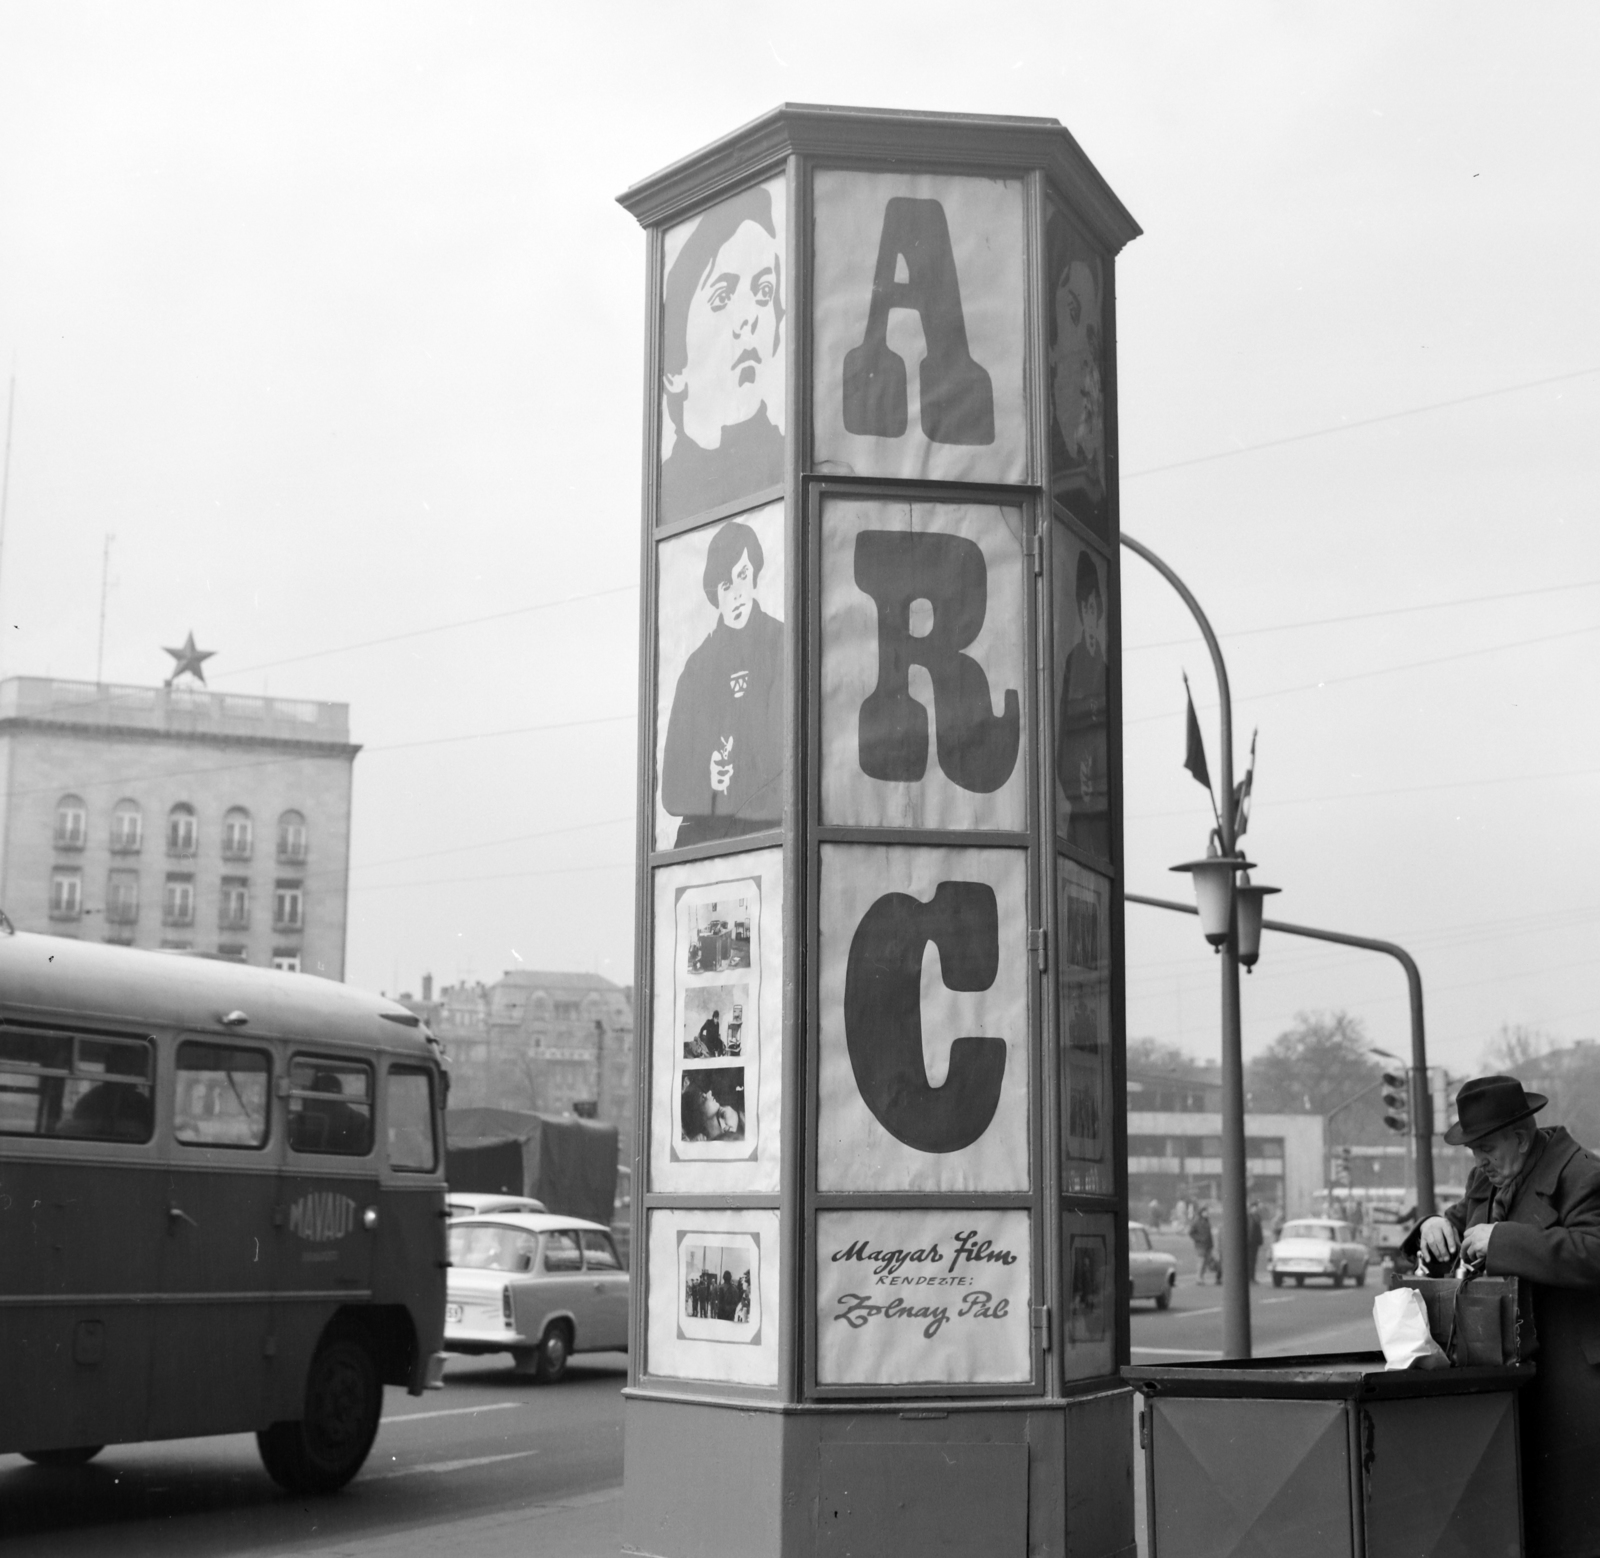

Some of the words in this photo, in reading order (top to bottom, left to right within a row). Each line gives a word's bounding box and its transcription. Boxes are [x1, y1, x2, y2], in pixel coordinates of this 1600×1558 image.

[831, 1240, 943, 1275] Magyar
[875, 1275, 974, 1286] RENDEZTE:
[833, 1293, 950, 1339] Zolnay
[957, 1291, 1009, 1319] Pál
